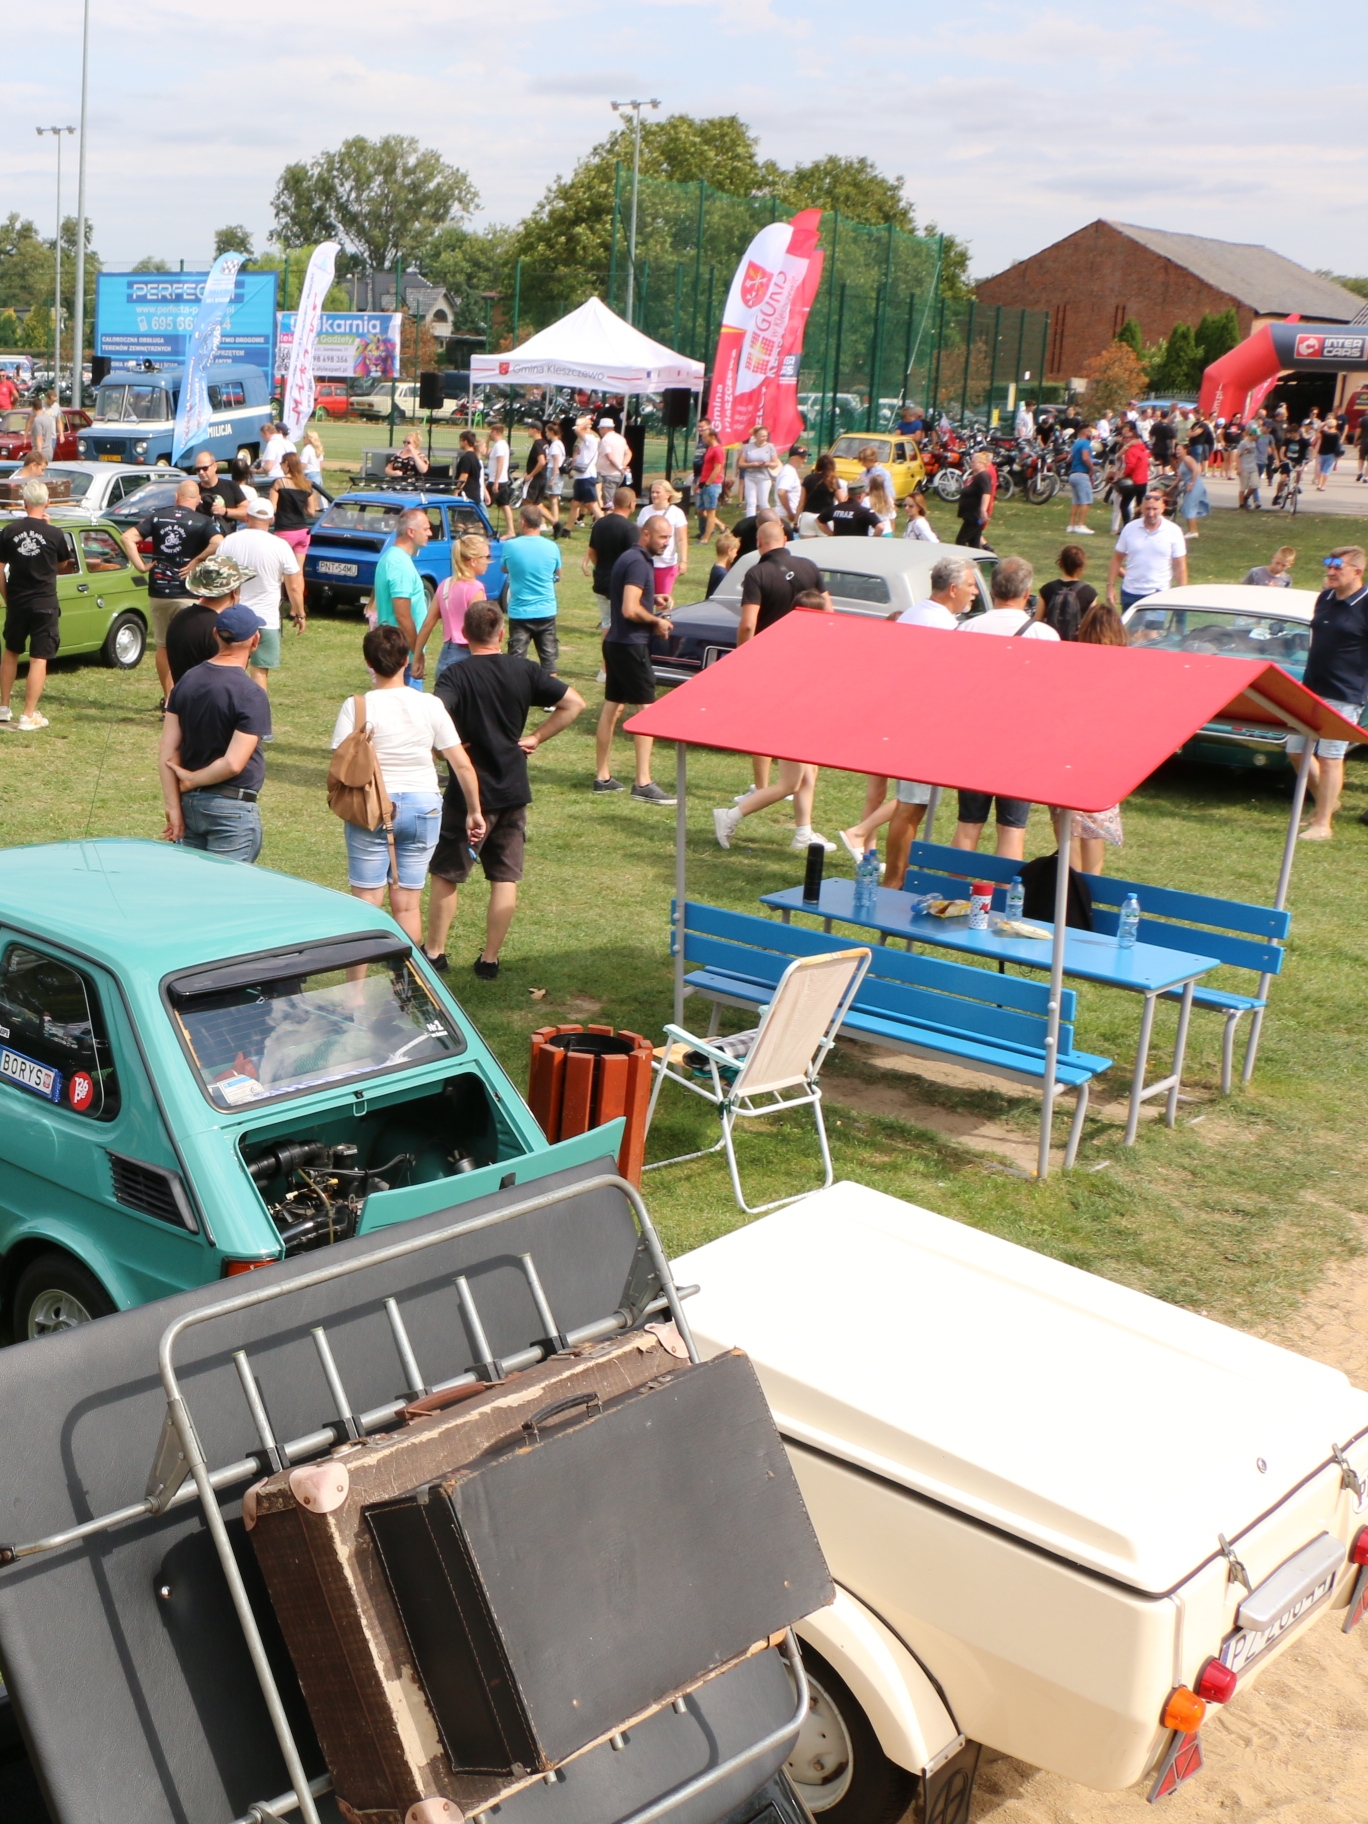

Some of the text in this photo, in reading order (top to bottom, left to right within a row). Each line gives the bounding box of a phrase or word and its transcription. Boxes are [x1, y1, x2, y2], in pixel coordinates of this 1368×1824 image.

[151, 316, 173, 330] 695
[1324, 338, 1363, 348] INTER
[1322, 347, 1362, 357] CARS
[513, 363, 605, 381] Gmina Kleszczewo
[711, 383, 723, 432] Gmina
[208, 423, 232, 438] MILICJA
[3, 1053, 43, 1087] BORYS
